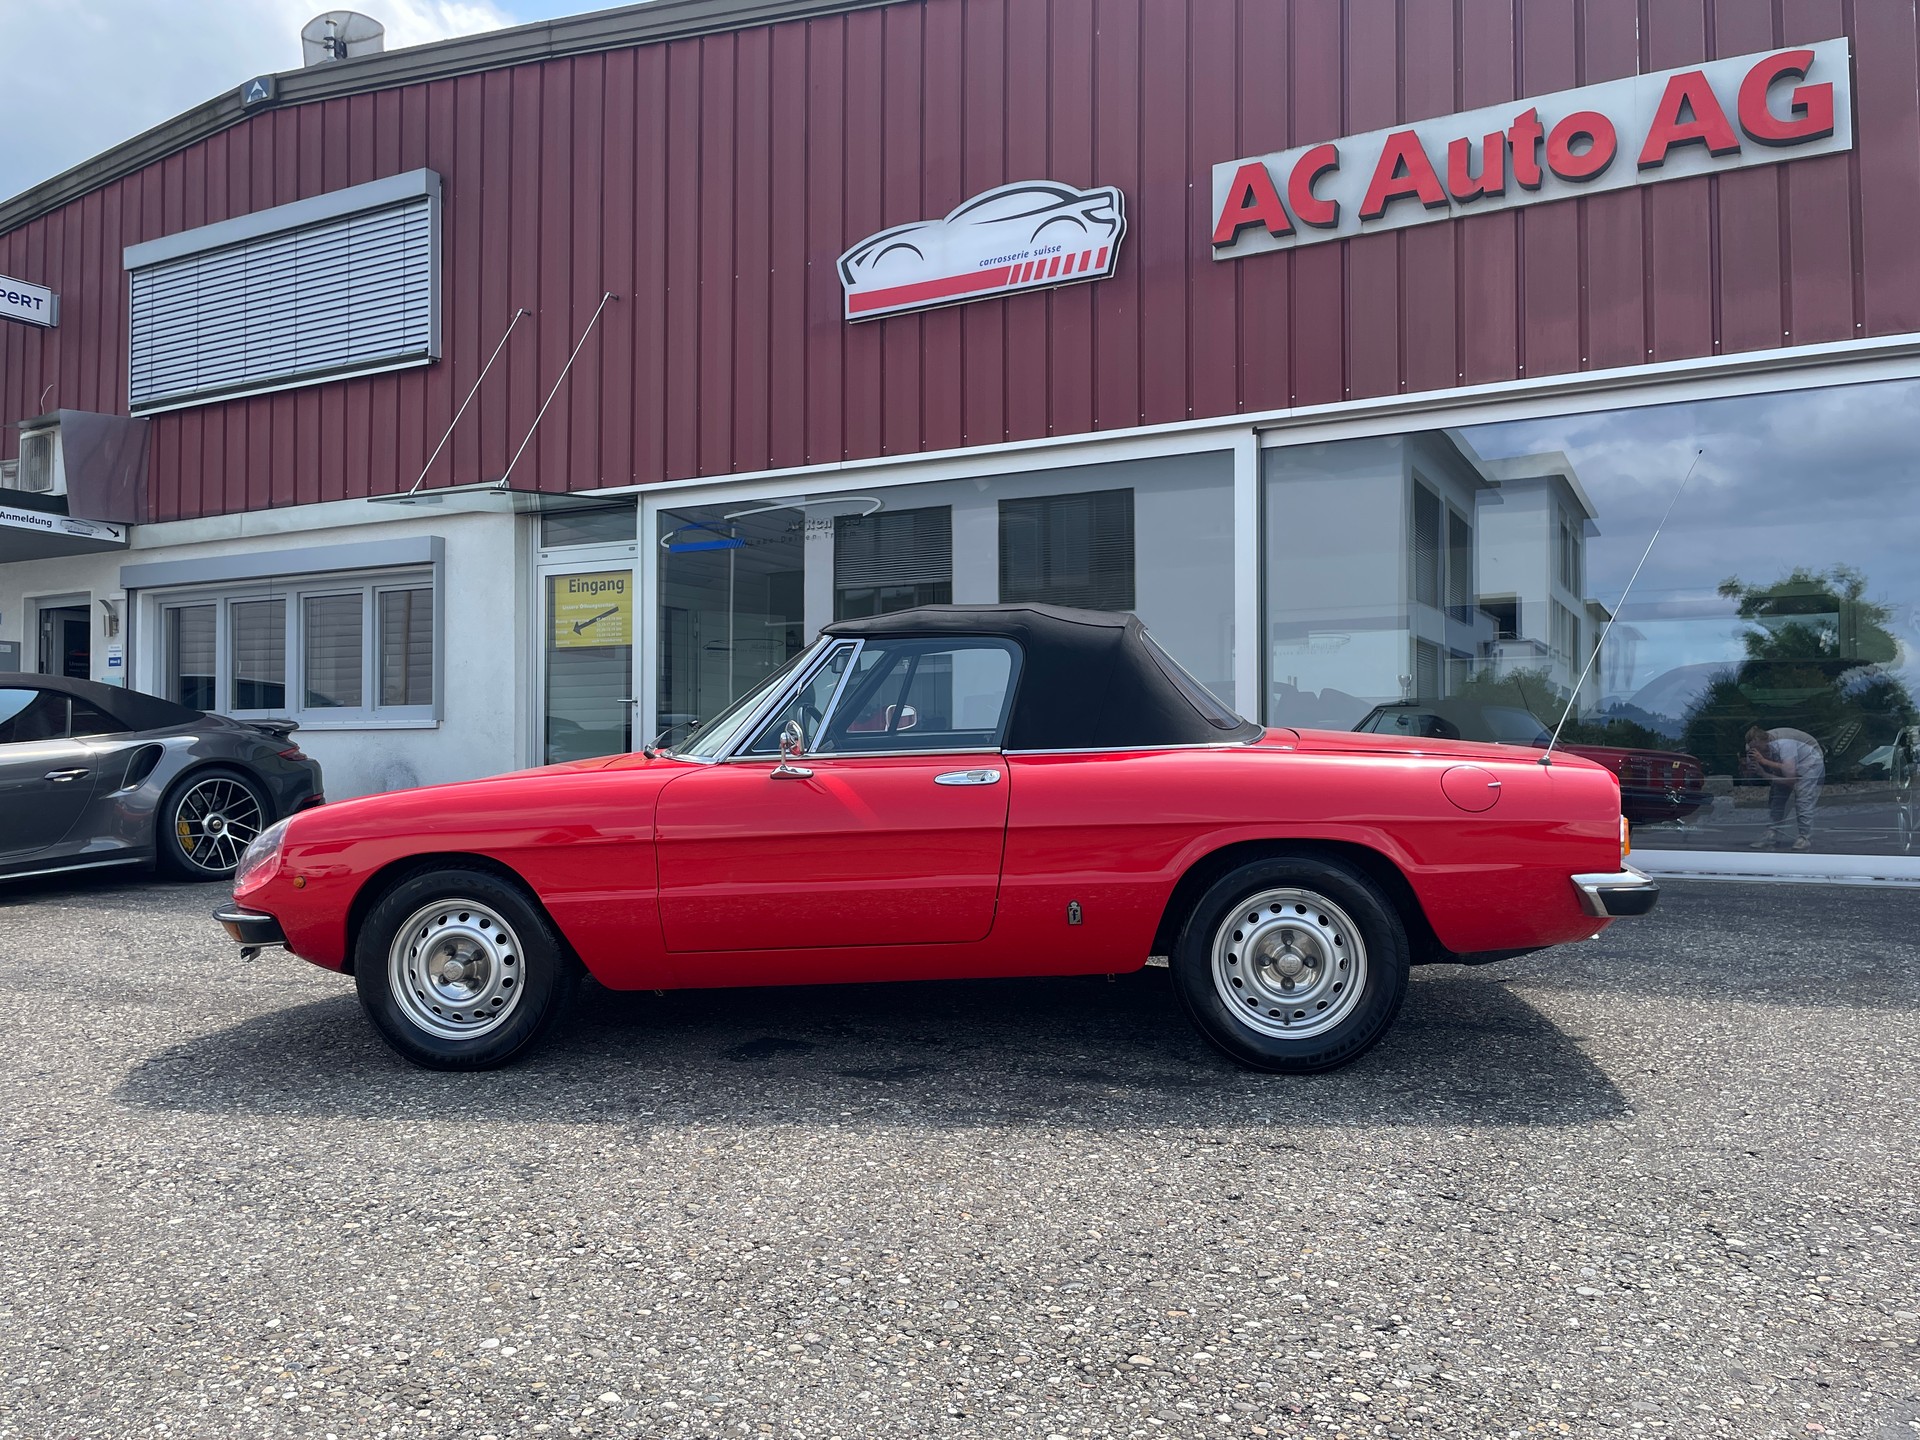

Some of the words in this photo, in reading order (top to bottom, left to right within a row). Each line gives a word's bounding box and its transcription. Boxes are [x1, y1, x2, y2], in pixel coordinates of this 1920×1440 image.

[1211, 144, 1341, 249] AC
[1357, 106, 1618, 222] Auto
[1637, 49, 1835, 172] AG
[978, 250, 1029, 267] carrosserie
[1033, 244, 1062, 257] suisse
[0, 511, 53, 528] Anmeldung
[569, 579, 624, 595] Eingang
